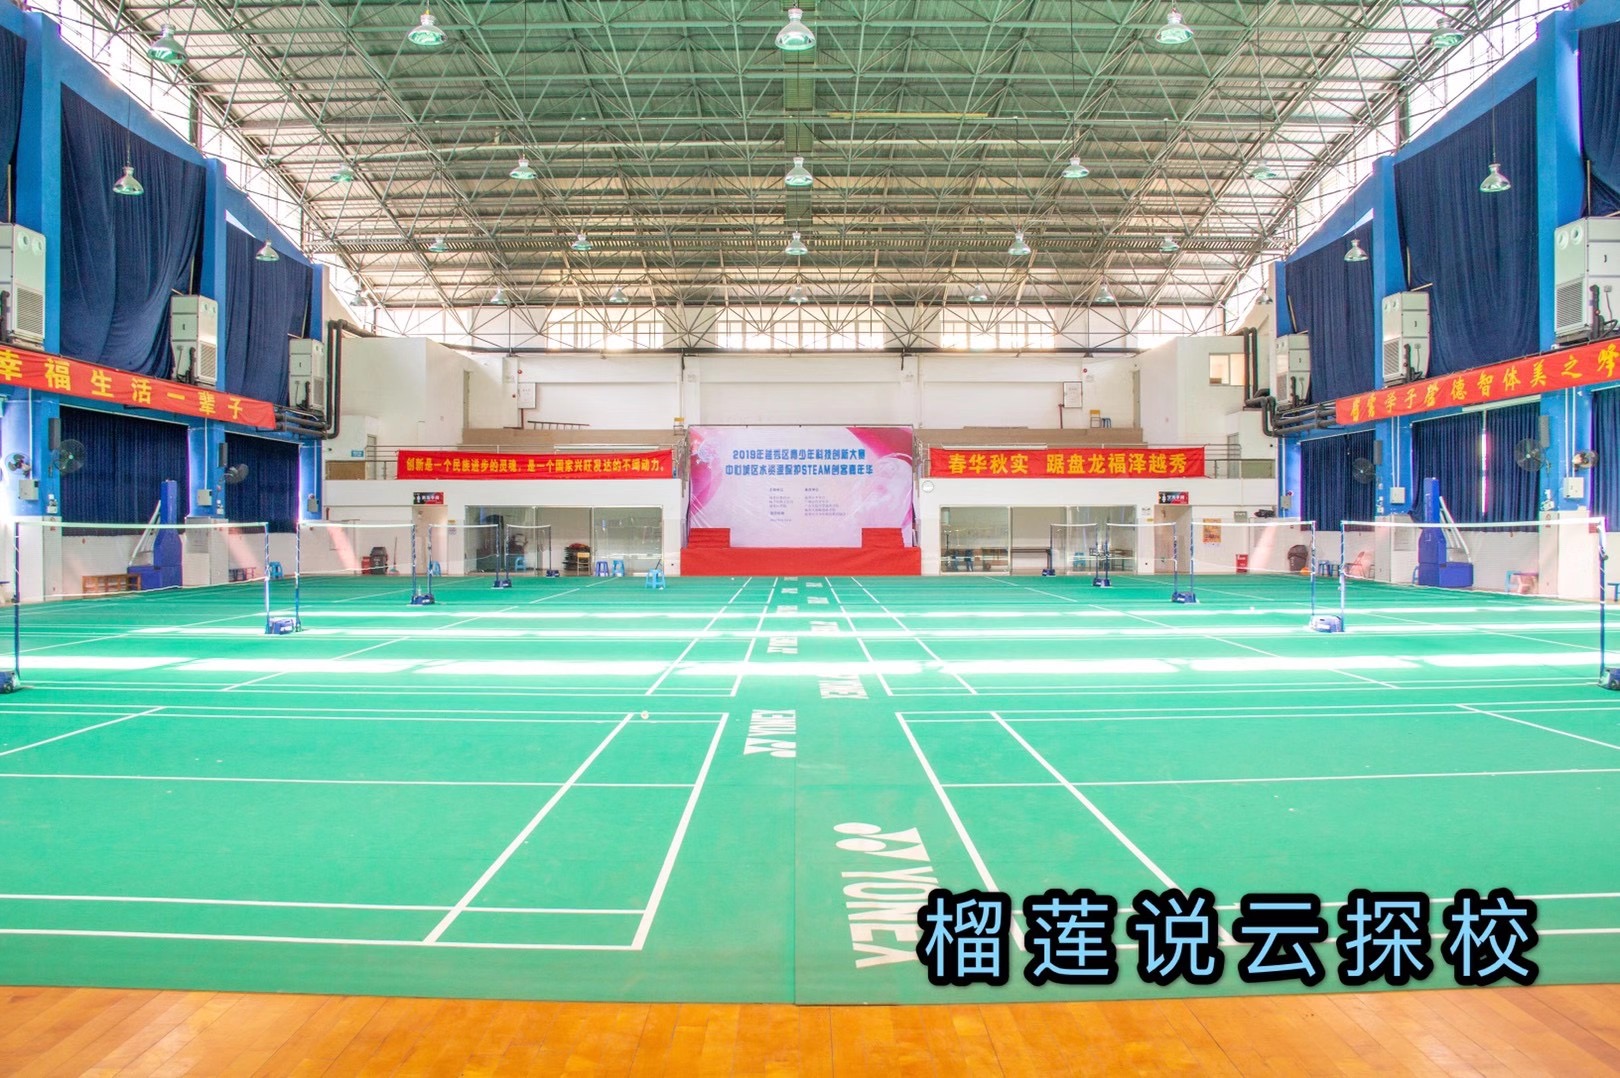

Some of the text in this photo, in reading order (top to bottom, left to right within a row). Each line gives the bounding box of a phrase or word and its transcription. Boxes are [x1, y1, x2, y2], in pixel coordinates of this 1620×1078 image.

[948, 453, 1187, 474] 春华秋实 踞盘龙福泽越秀
